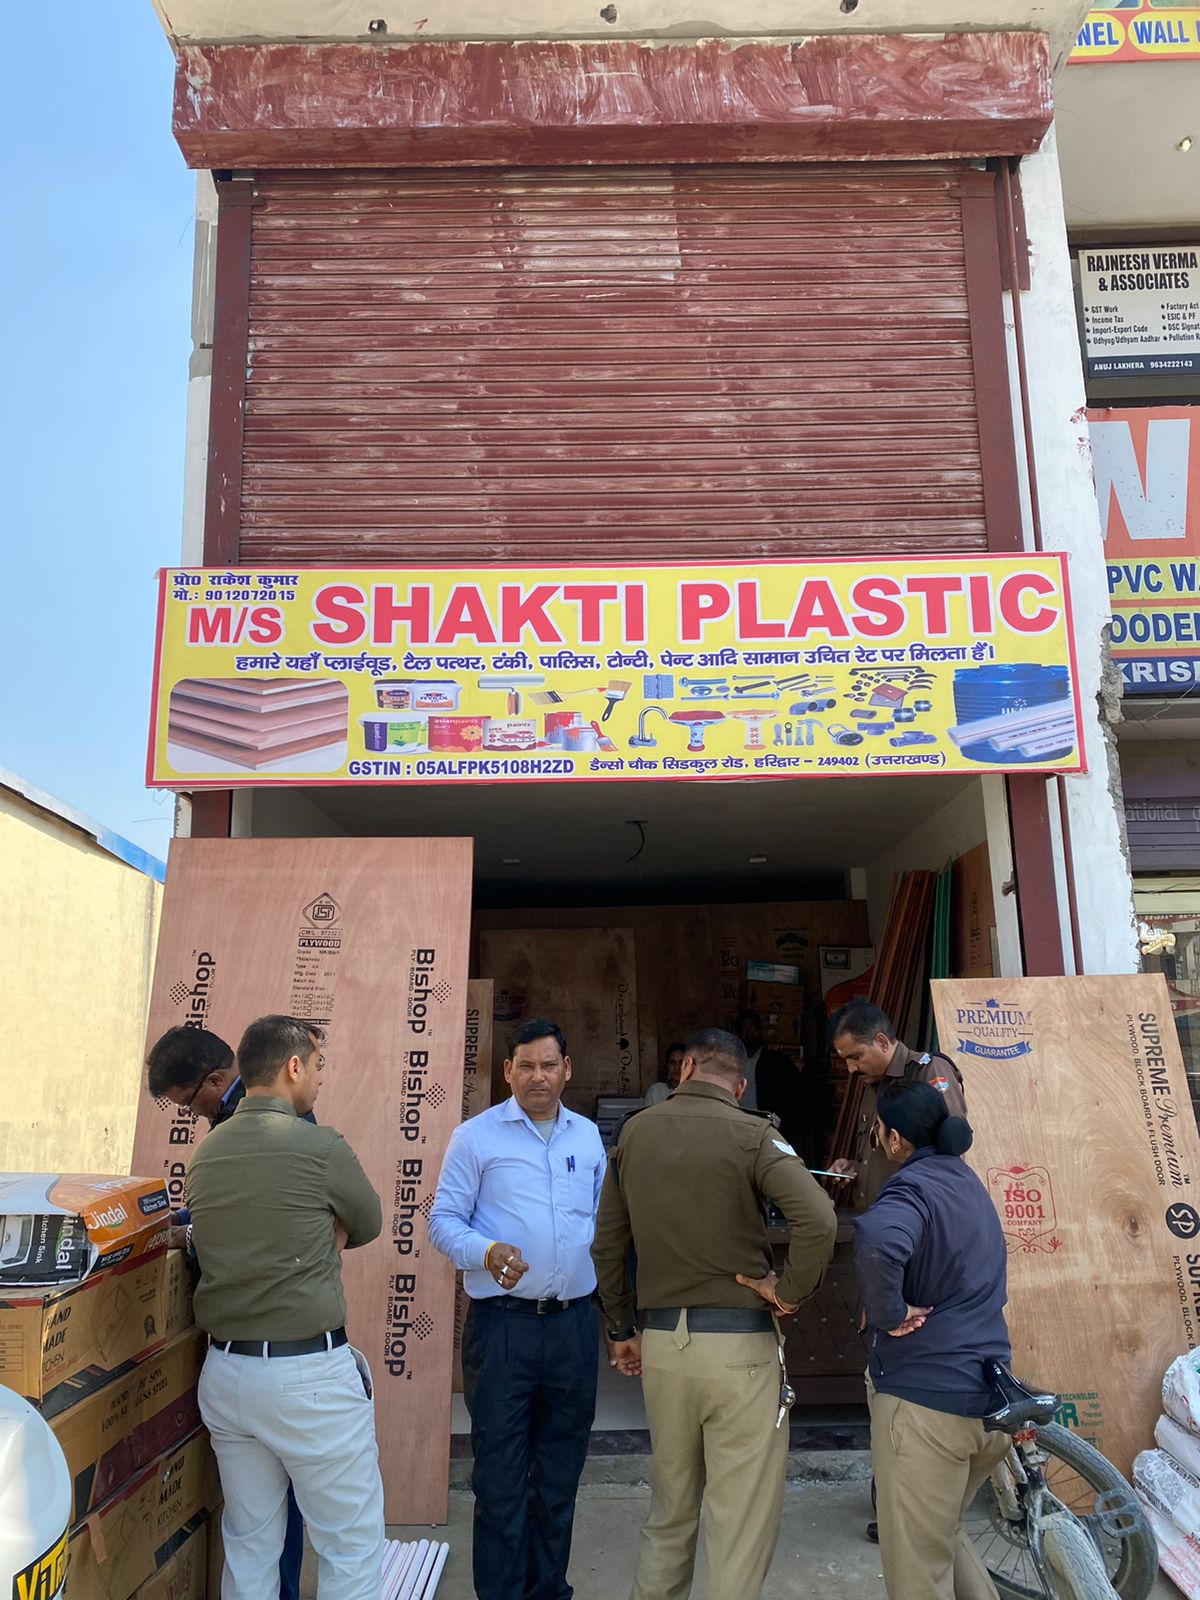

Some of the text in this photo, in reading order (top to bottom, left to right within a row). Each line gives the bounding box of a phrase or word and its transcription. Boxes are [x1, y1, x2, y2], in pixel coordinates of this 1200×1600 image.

[1133, 21, 1190, 44] WALL
[1087, 252, 1198, 272] RAJNEESH VERMA
[1098, 272, 1189, 291] & ASSOCIATES
[1166, 303, 1188, 311] Factory
[256, 575, 299, 589] कुमार
[1106, 564, 1163, 594] PVC
[188, 573, 1058, 644] M/S SHAKTI PLASTIC
[205, 590, 295, 601] 9012072015
[235, 651, 282, 670] हमारे
[285, 651, 321, 670] यहाँ
[435, 656, 486, 670] पत्थर,
[492, 651, 533, 670] टंकी,
[539, 650, 600, 670] पालिस,
[606, 649, 653, 669] टोन्टी,
[660, 649, 694, 667] पेन्ट
[697, 648, 738, 666] आदि
[743, 650, 800, 665] सामान
[804, 645, 850, 663] उचित
[855, 645, 877, 662] रेट
[881, 648, 906, 661] पर
[909, 643, 967, 660] मिलता
[349, 761, 401, 776] GSTIN
[416, 759, 574, 775] 05ALFPK5108H2ZD
[628, 757, 658, 770] चौक
[663, 756, 719, 773] सिडकुल
[754, 754, 801, 768] हरिद्वार
[817, 756, 859, 767] 249402
[865, 750, 946, 769] (उत्तराखण्ड)
[299, 939, 341, 948] PLYWOOD
[407, 949, 435, 1034] Bishop
[463, 1008, 480, 1075] SUPREME
[973, 1027, 1018, 1038] QUALITY
[1126, 1014, 1139, 1056] PLYWOOD,
[974, 1045, 1020, 1057] GUARANTEE
[1134, 1058, 1146, 1086] BLOCK
[400, 1051, 429, 1141] Bishop
[1138, 1013, 1171, 1095] SUPREME
[1155, 1097, 1183, 1189] Premium
[1140, 1089, 1152, 1119] BOARD
[1149, 1129, 1160, 1157] FLUSH
[1154, 1160, 1165, 1186] DOOR
[393, 1159, 422, 1255] Bishop
[1003, 1189, 1042, 1203] ISO
[86, 1202, 128, 1230] Jindal
[1005, 1204, 1046, 1219] 9001
[34, 1246, 46, 1264] Sink
[55, 1217, 78, 1270] indal
[386, 1296, 394, 1326] BOARD
[1173, 1255, 1188, 1305] PLYWOOD,
[1182, 1306, 1195, 1340] BLOCK
[45, 1306, 72, 1332] HAND
[384, 1274, 416, 1377] Bishop
